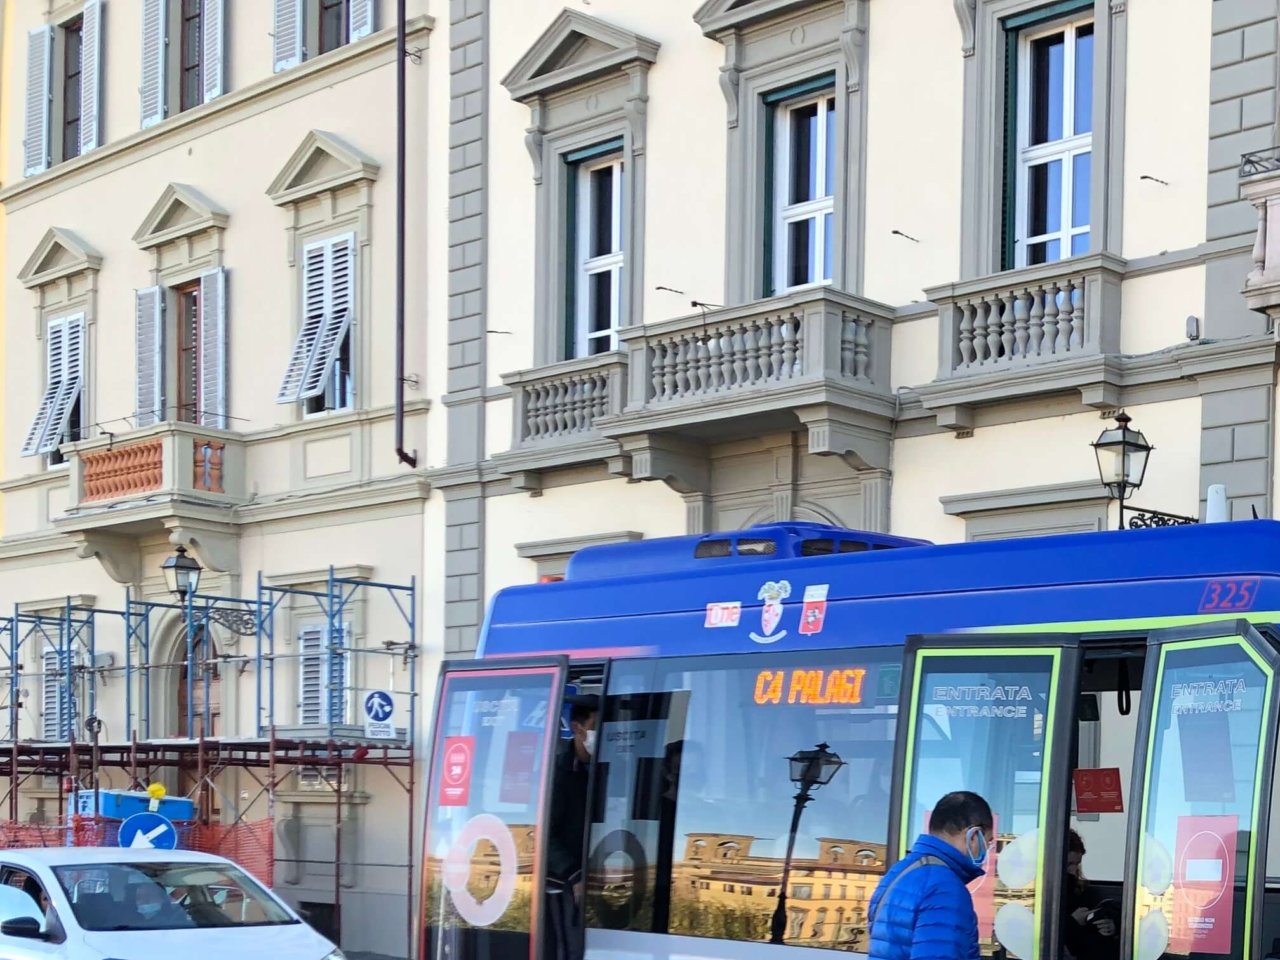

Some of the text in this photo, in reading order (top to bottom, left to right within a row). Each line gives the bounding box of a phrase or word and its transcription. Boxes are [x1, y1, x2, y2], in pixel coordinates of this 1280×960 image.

[1205, 580, 1253, 609] 325
[932, 685, 1033, 701] ENTRATA
[1170, 678, 1247, 699] ENTRATA
[935, 705, 1028, 719] ENTRANCE
[1173, 699, 1242, 715] ENTRANCE
